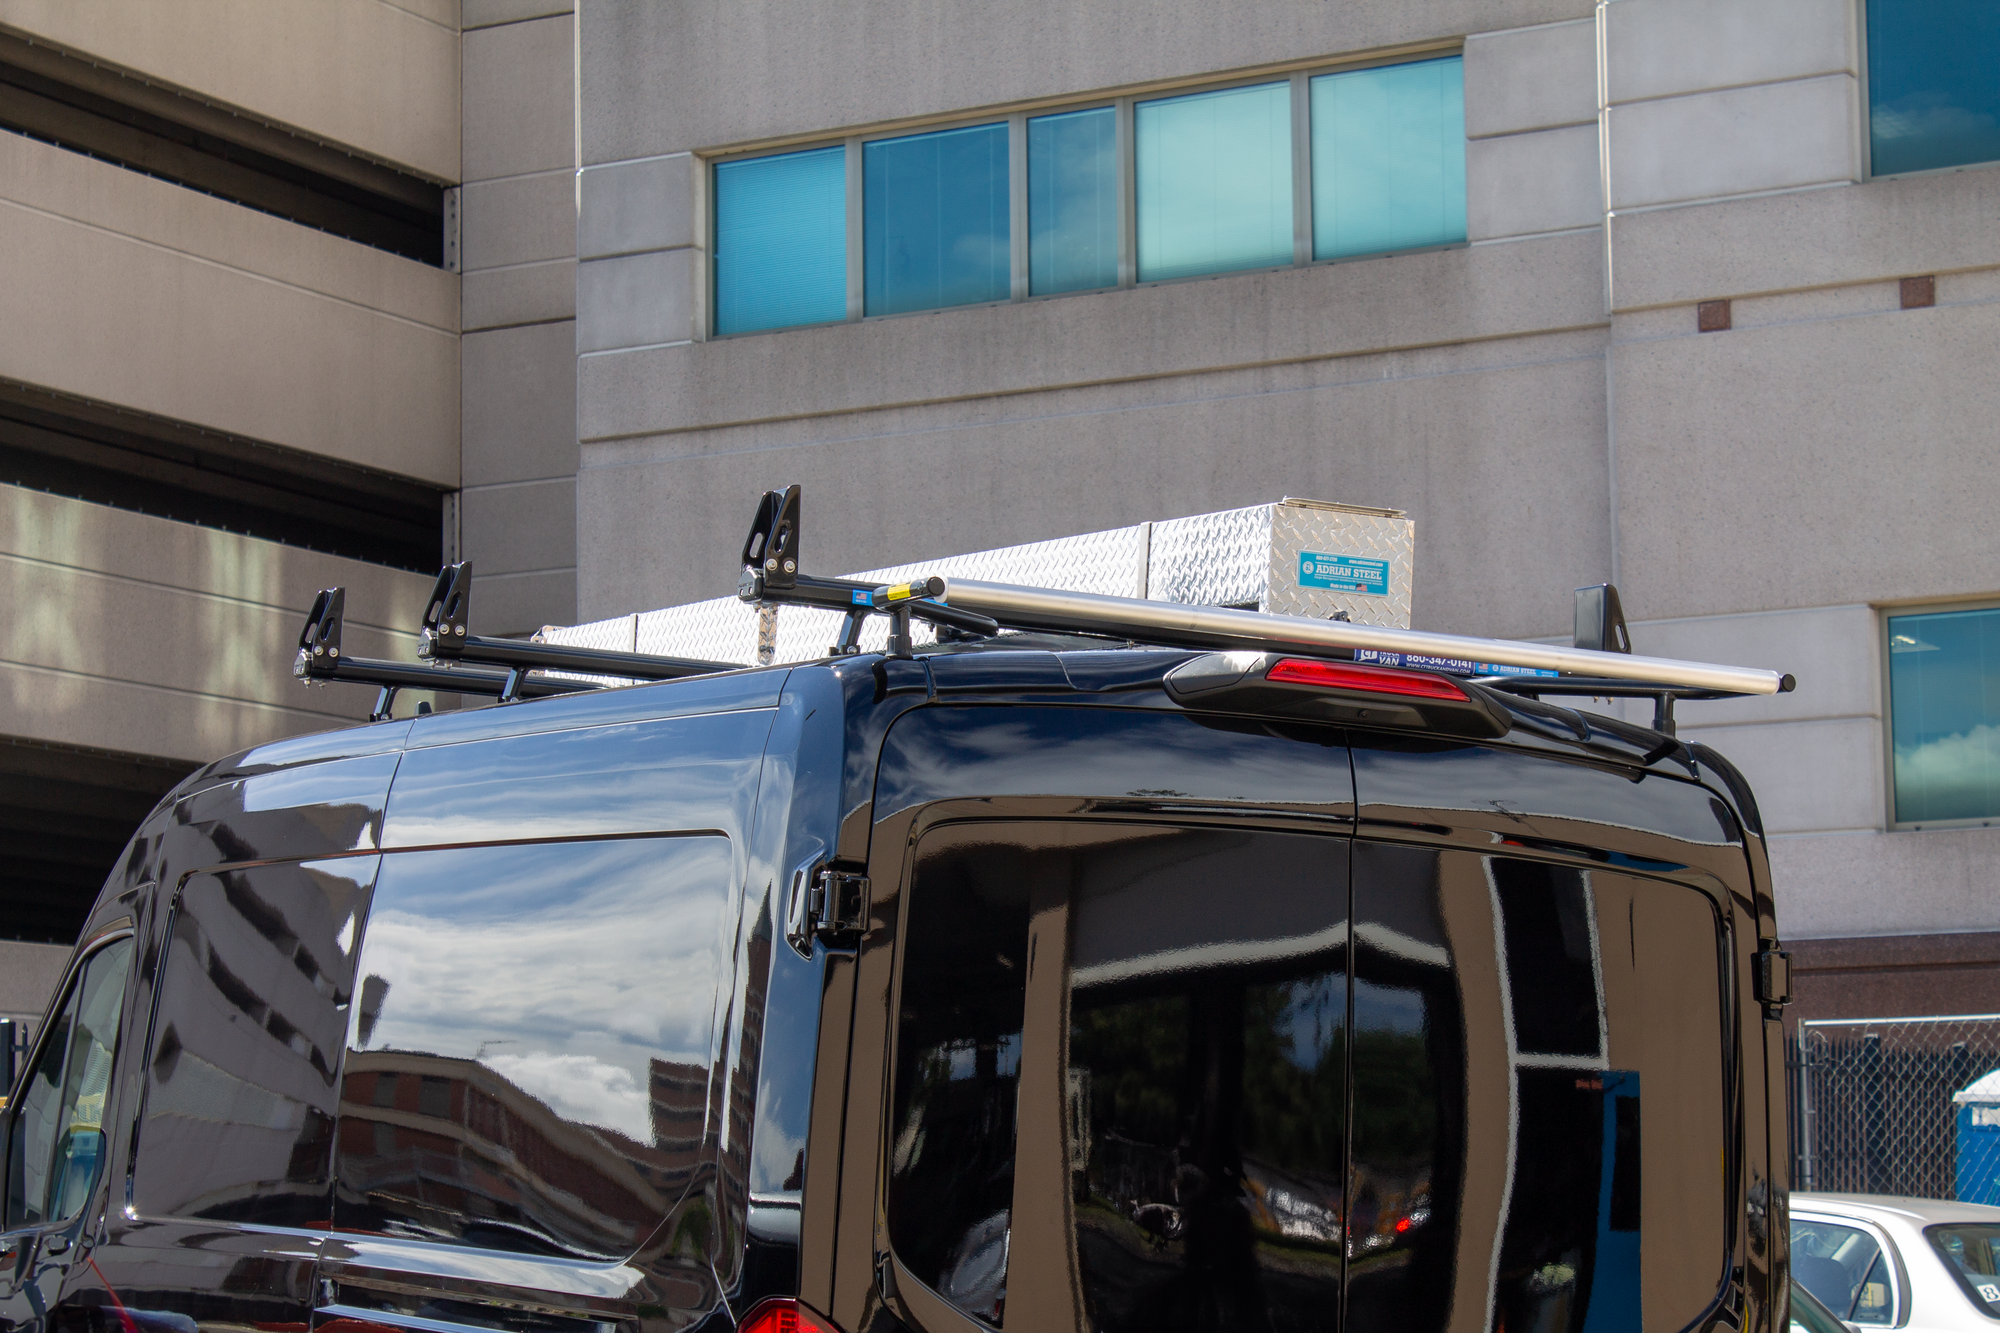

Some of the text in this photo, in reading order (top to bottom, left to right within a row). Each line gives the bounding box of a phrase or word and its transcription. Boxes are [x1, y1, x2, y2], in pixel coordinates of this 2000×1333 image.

[1316, 565, 1382, 579] ADRIAN STEEL
[1379, 657, 1399, 666] VAN
[1406, 663, 1470, 673] WWW.CTTRUCKANDVAN.COM
[1983, 1287, 1999, 1300] 8
